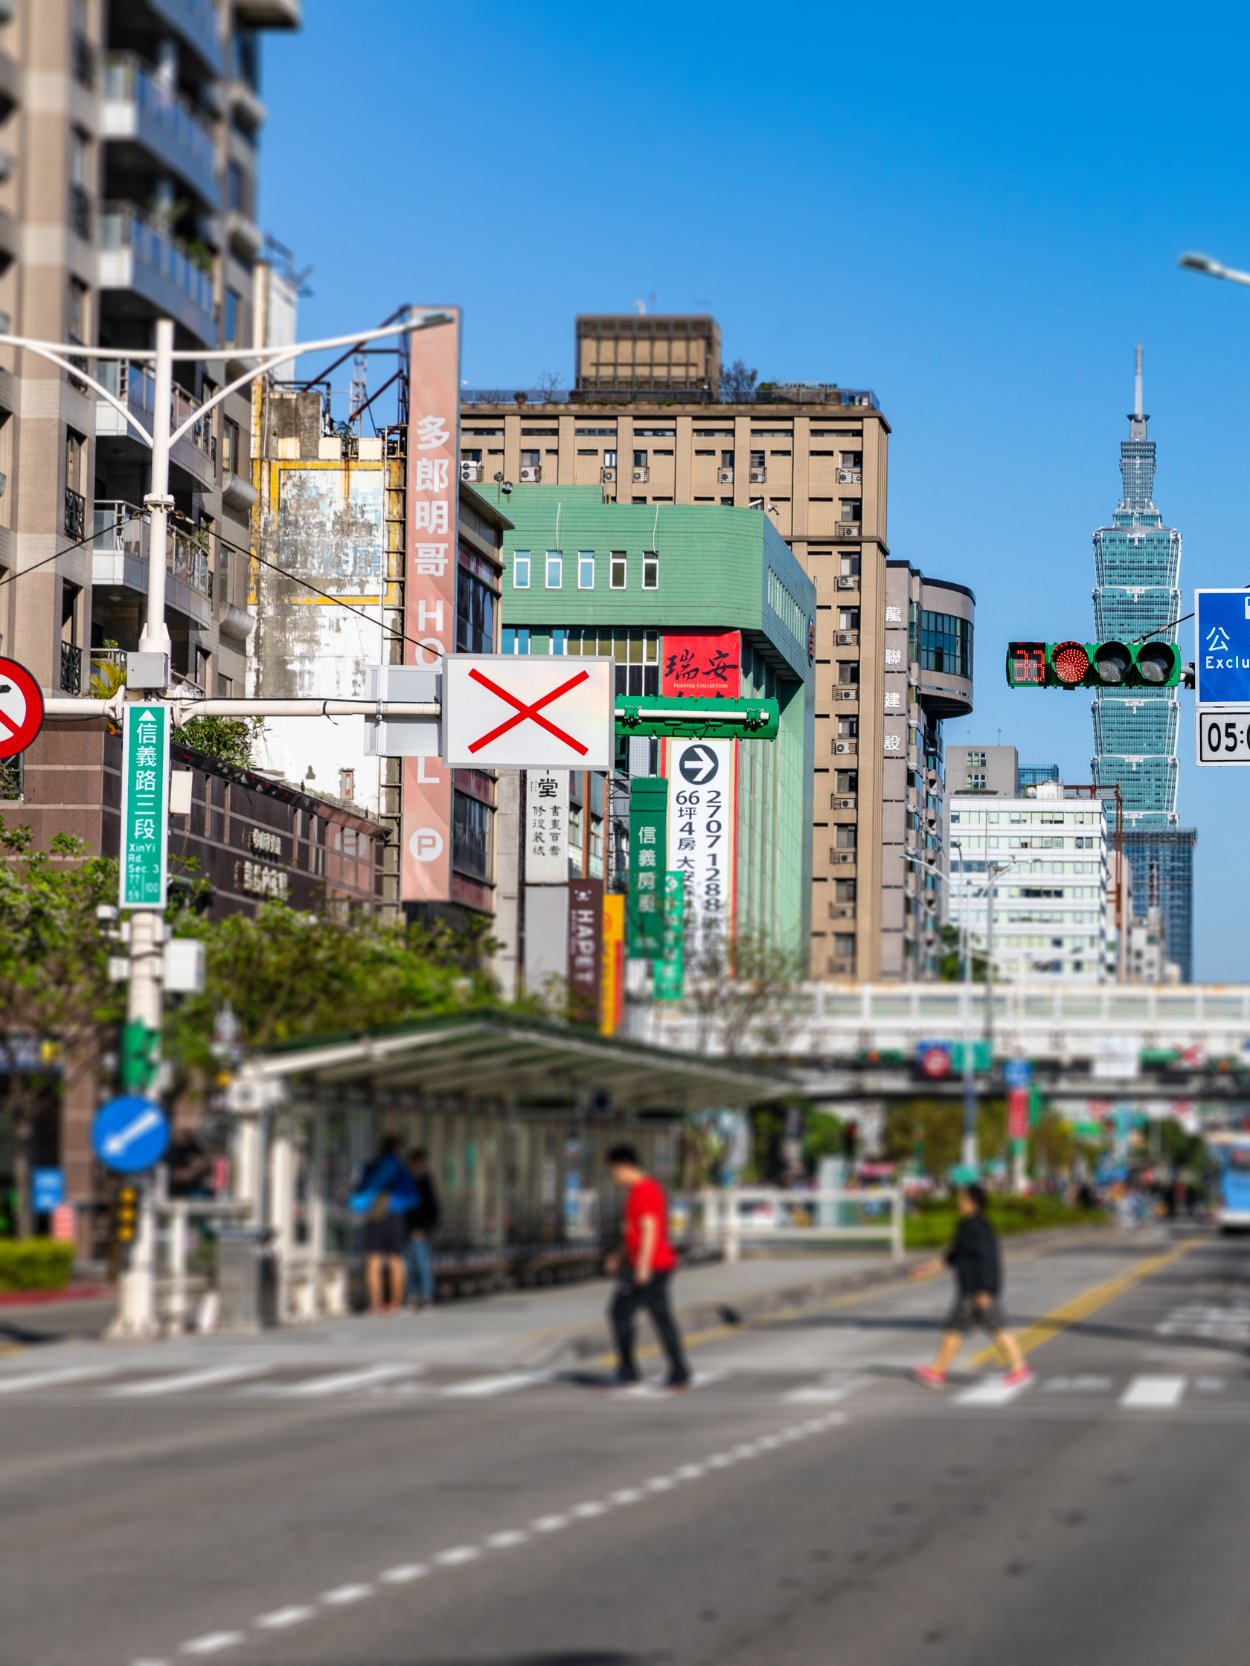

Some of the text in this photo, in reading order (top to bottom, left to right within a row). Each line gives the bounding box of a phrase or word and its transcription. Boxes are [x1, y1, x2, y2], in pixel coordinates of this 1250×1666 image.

[414, 414, 450, 784] 多郎明哥 HOL
[664, 648, 739, 682] 瑞安
[883, 605, 902, 751] 龍聯建設
[1015, 649, 1046, 682] 33
[134, 722, 158, 840] 信義路三段
[705, 790, 722, 849] 2707
[128, 842, 156, 853] XinYi
[417, 834, 437, 857] P
[128, 874, 140, 884] 77
[152, 863, 160, 874] 3
[575, 909, 595, 985] HAPET
